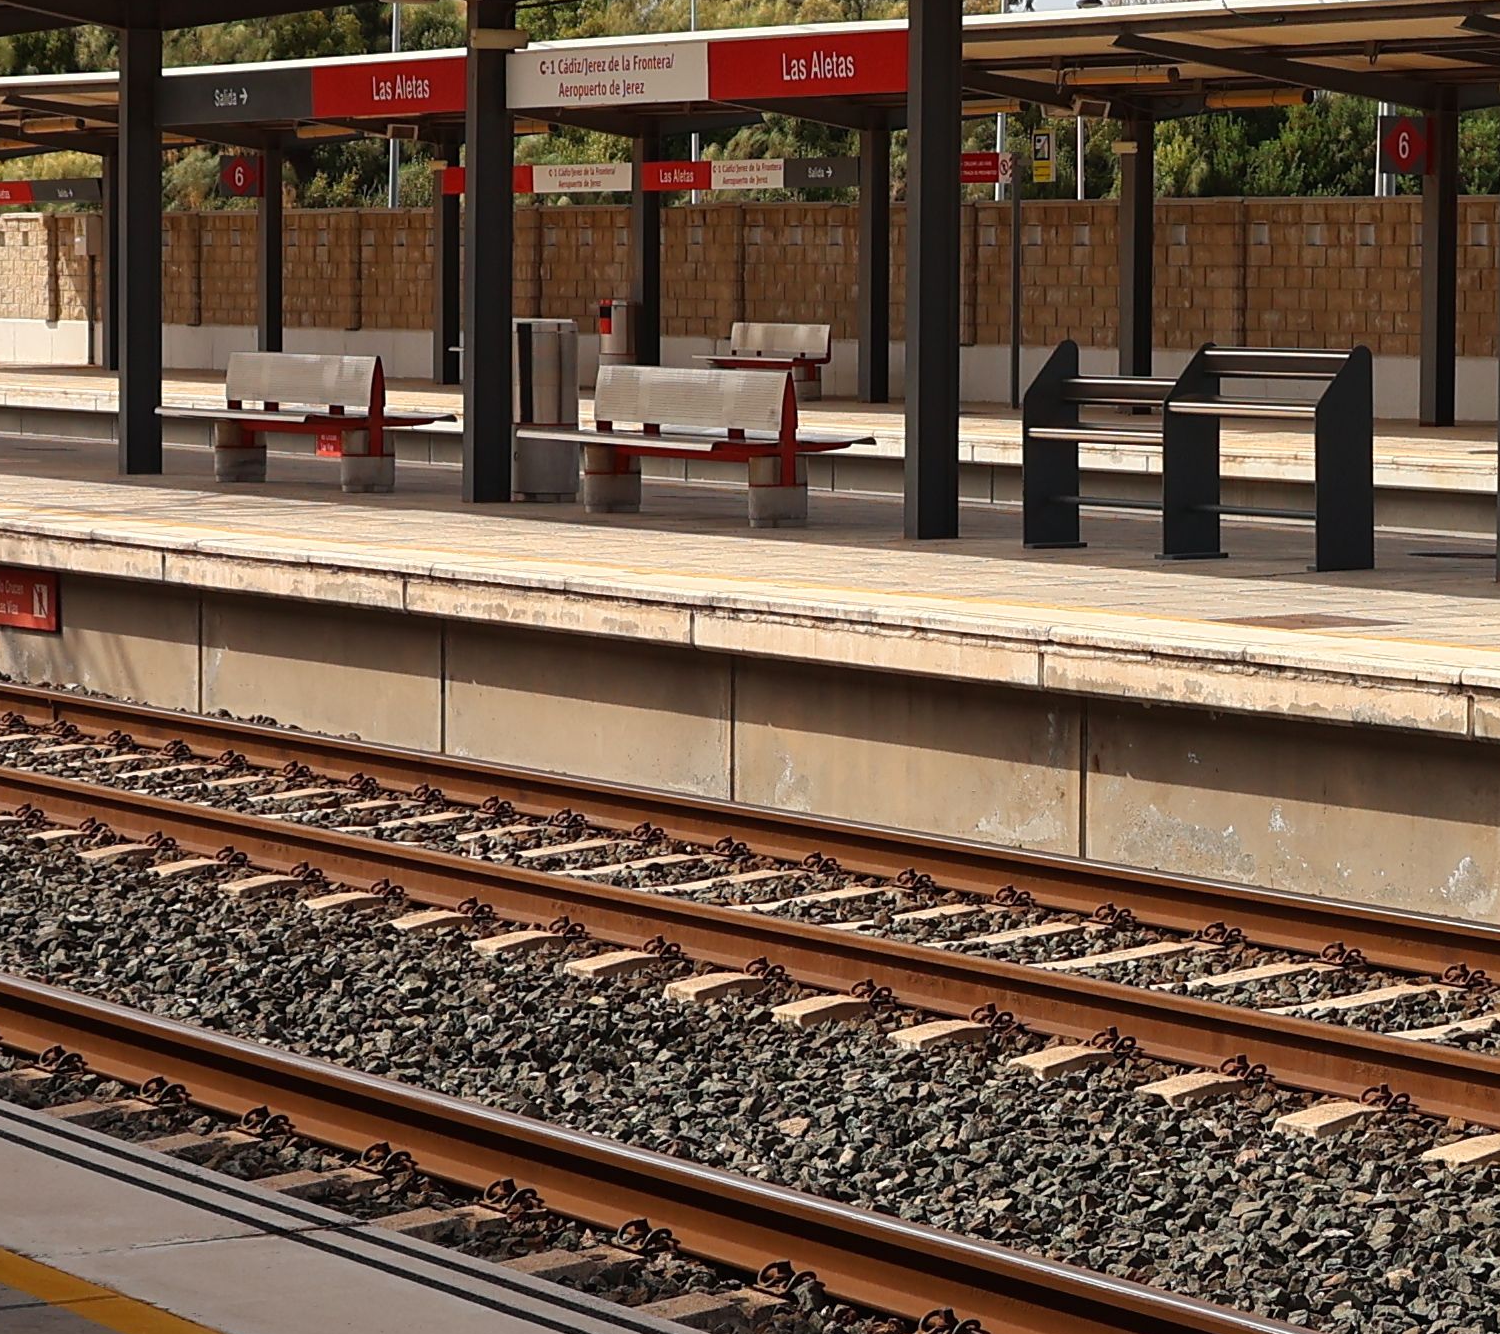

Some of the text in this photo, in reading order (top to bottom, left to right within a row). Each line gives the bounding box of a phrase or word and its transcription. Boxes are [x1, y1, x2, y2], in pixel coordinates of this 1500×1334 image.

[539, 53, 674, 76] C-1 Cádiz/Jerez de la Frontera/
[782, 51, 854, 81] Las Aletas
[214, 89, 237, 107] Salida
[372, 75, 430, 101] Las Aletas
[558, 80, 645, 100] Aeropuerto de Jerez
[1398, 131, 1409, 159] 6
[235, 166, 244, 187] 6
[660, 168, 694, 184] Las Aletas
